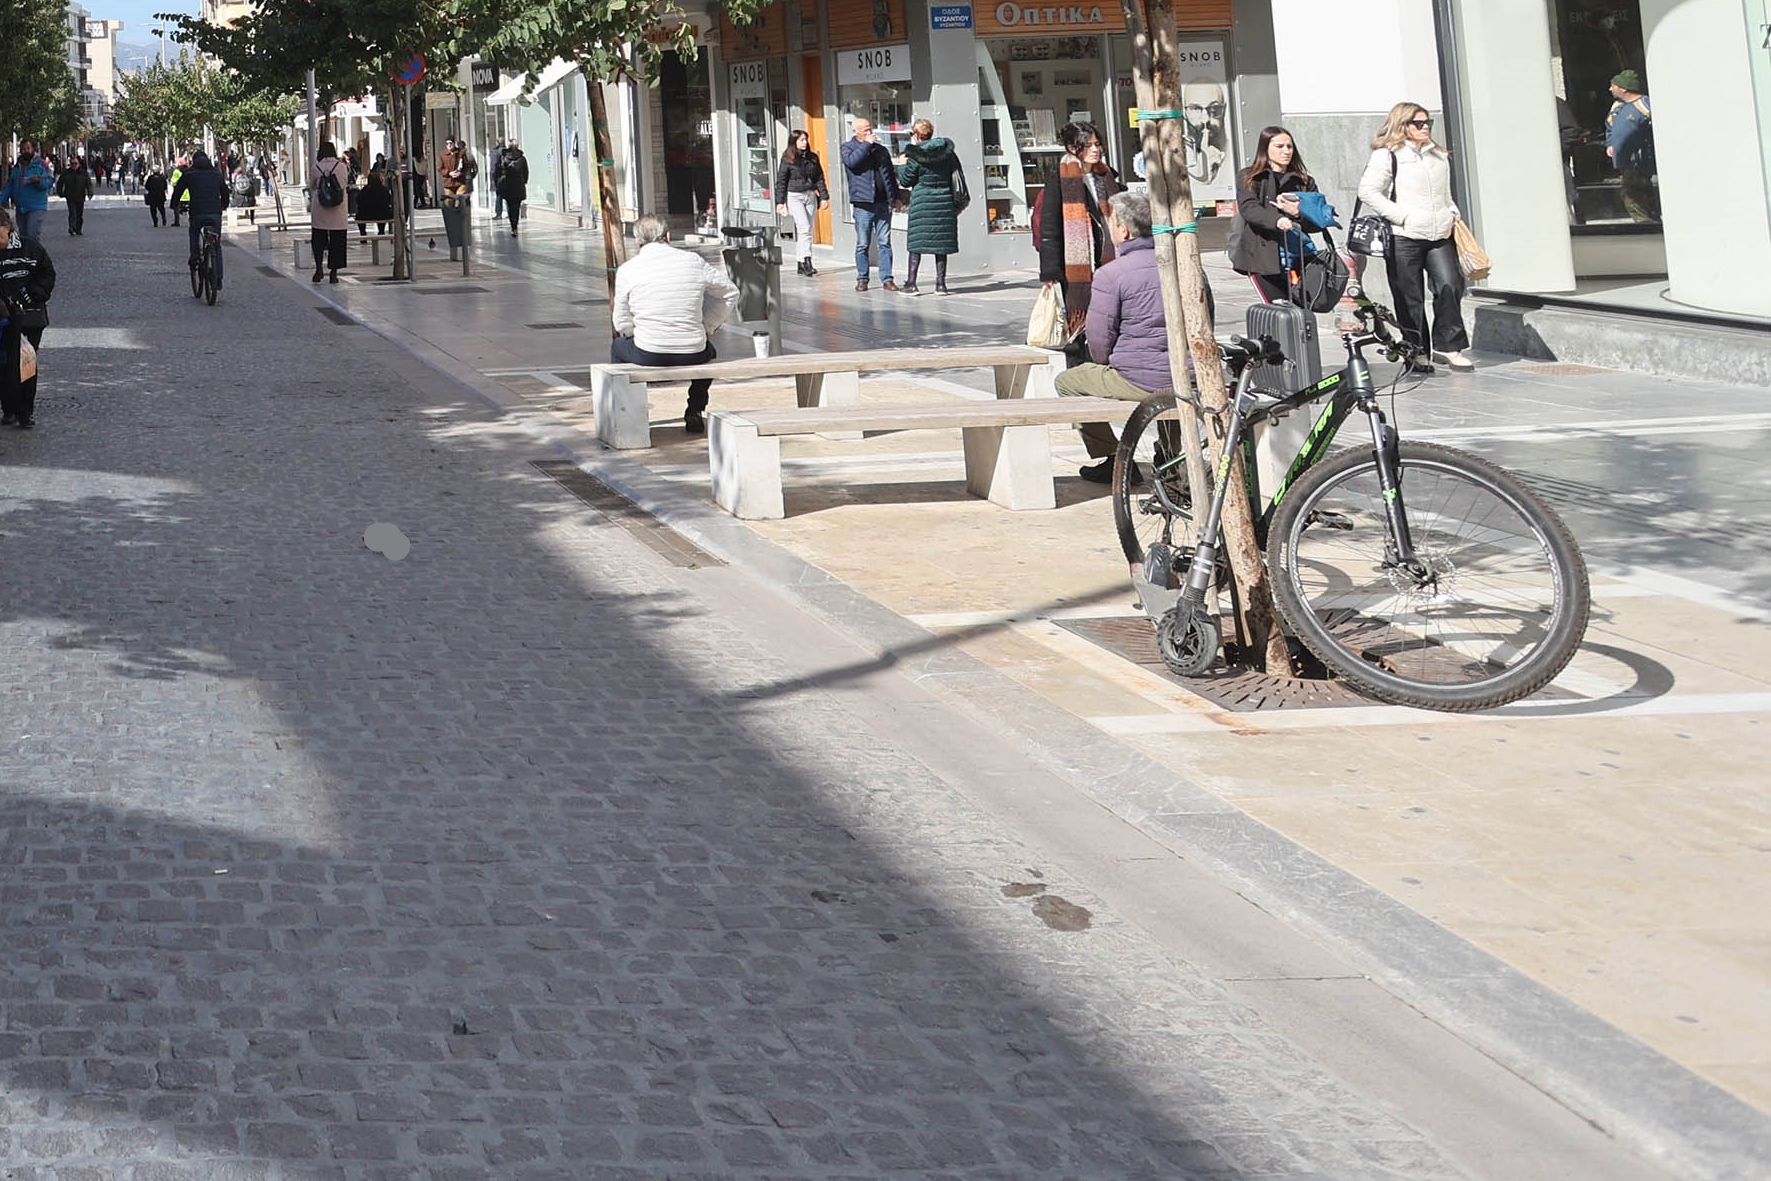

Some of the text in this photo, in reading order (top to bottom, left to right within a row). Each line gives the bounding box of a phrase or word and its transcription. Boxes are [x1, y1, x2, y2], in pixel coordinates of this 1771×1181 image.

[858, 49, 892, 69] SNOB
[1180, 52, 1221, 62] SNOB
[473, 68, 494, 85] NOVA
[733, 66, 764, 83] SNOB
